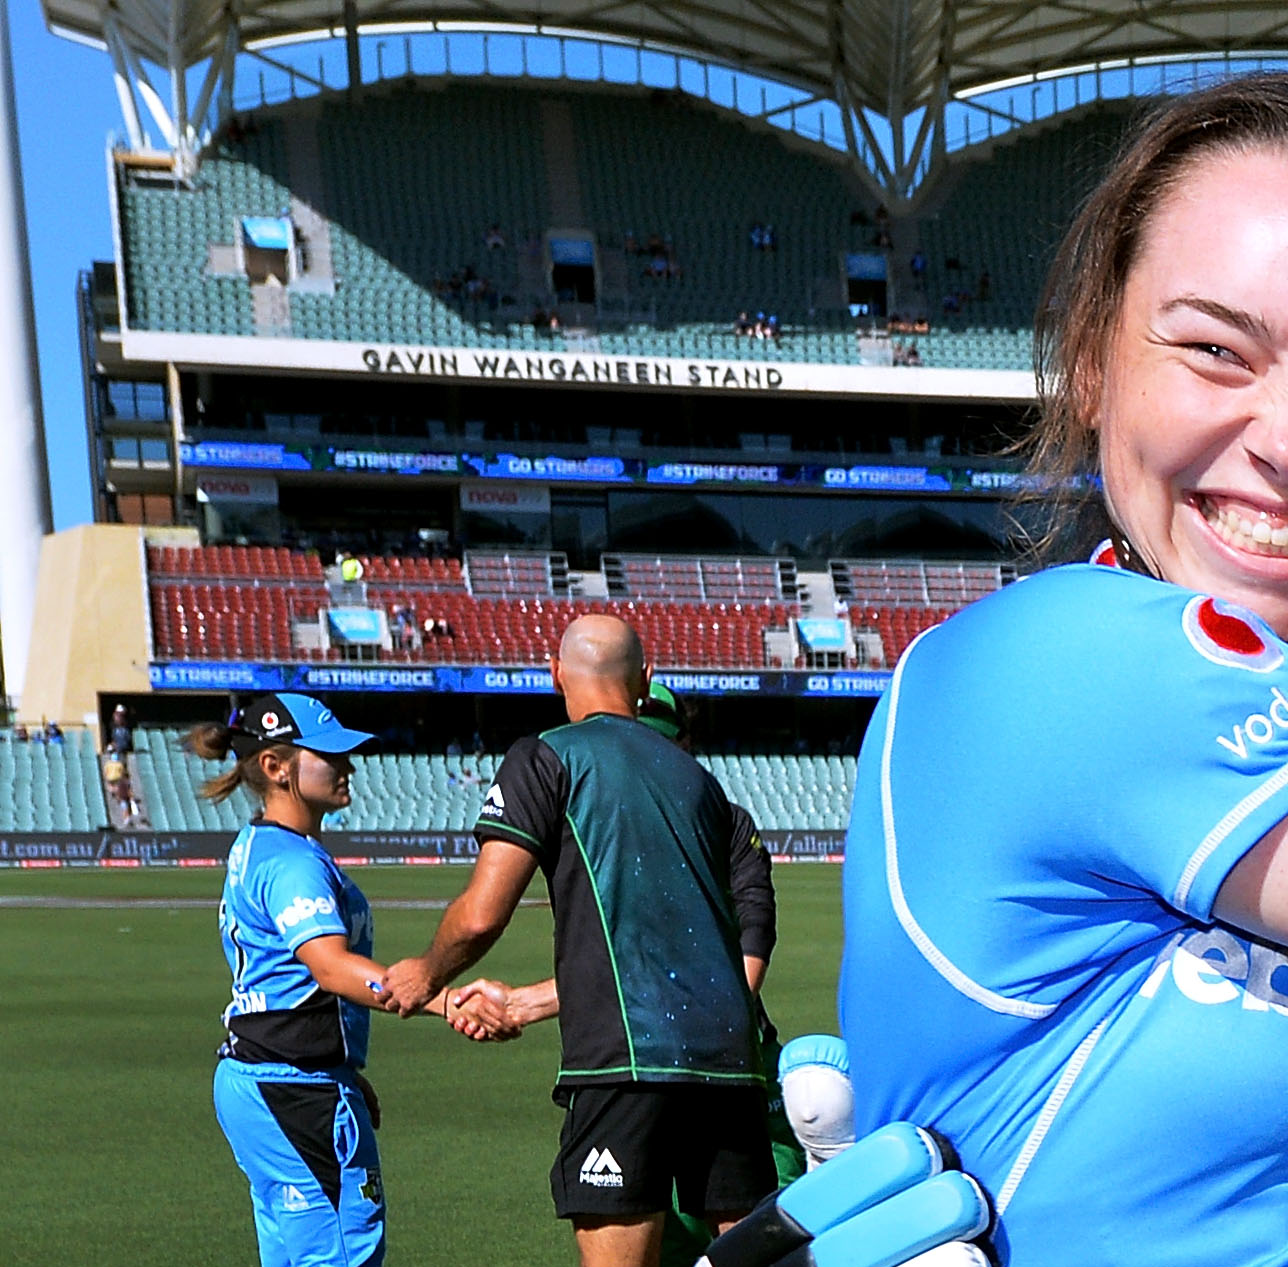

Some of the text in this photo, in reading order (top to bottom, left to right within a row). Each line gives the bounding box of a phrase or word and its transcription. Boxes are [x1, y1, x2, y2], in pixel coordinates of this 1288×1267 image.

[363, 349, 783, 388] GAVIN WANGANEEN STAND
[334, 451, 458, 472] #STRIKEFORCE
[509, 459, 531, 473] GO
[663, 463, 779, 482] #STRIKEFORCE
[826, 468, 846, 483] GO
[164, 667, 254, 685] STRIKERS
[307, 670, 433, 688] #STRIKEFORCE
[485, 671, 508, 688] GO
[808, 677, 831, 692] GO
